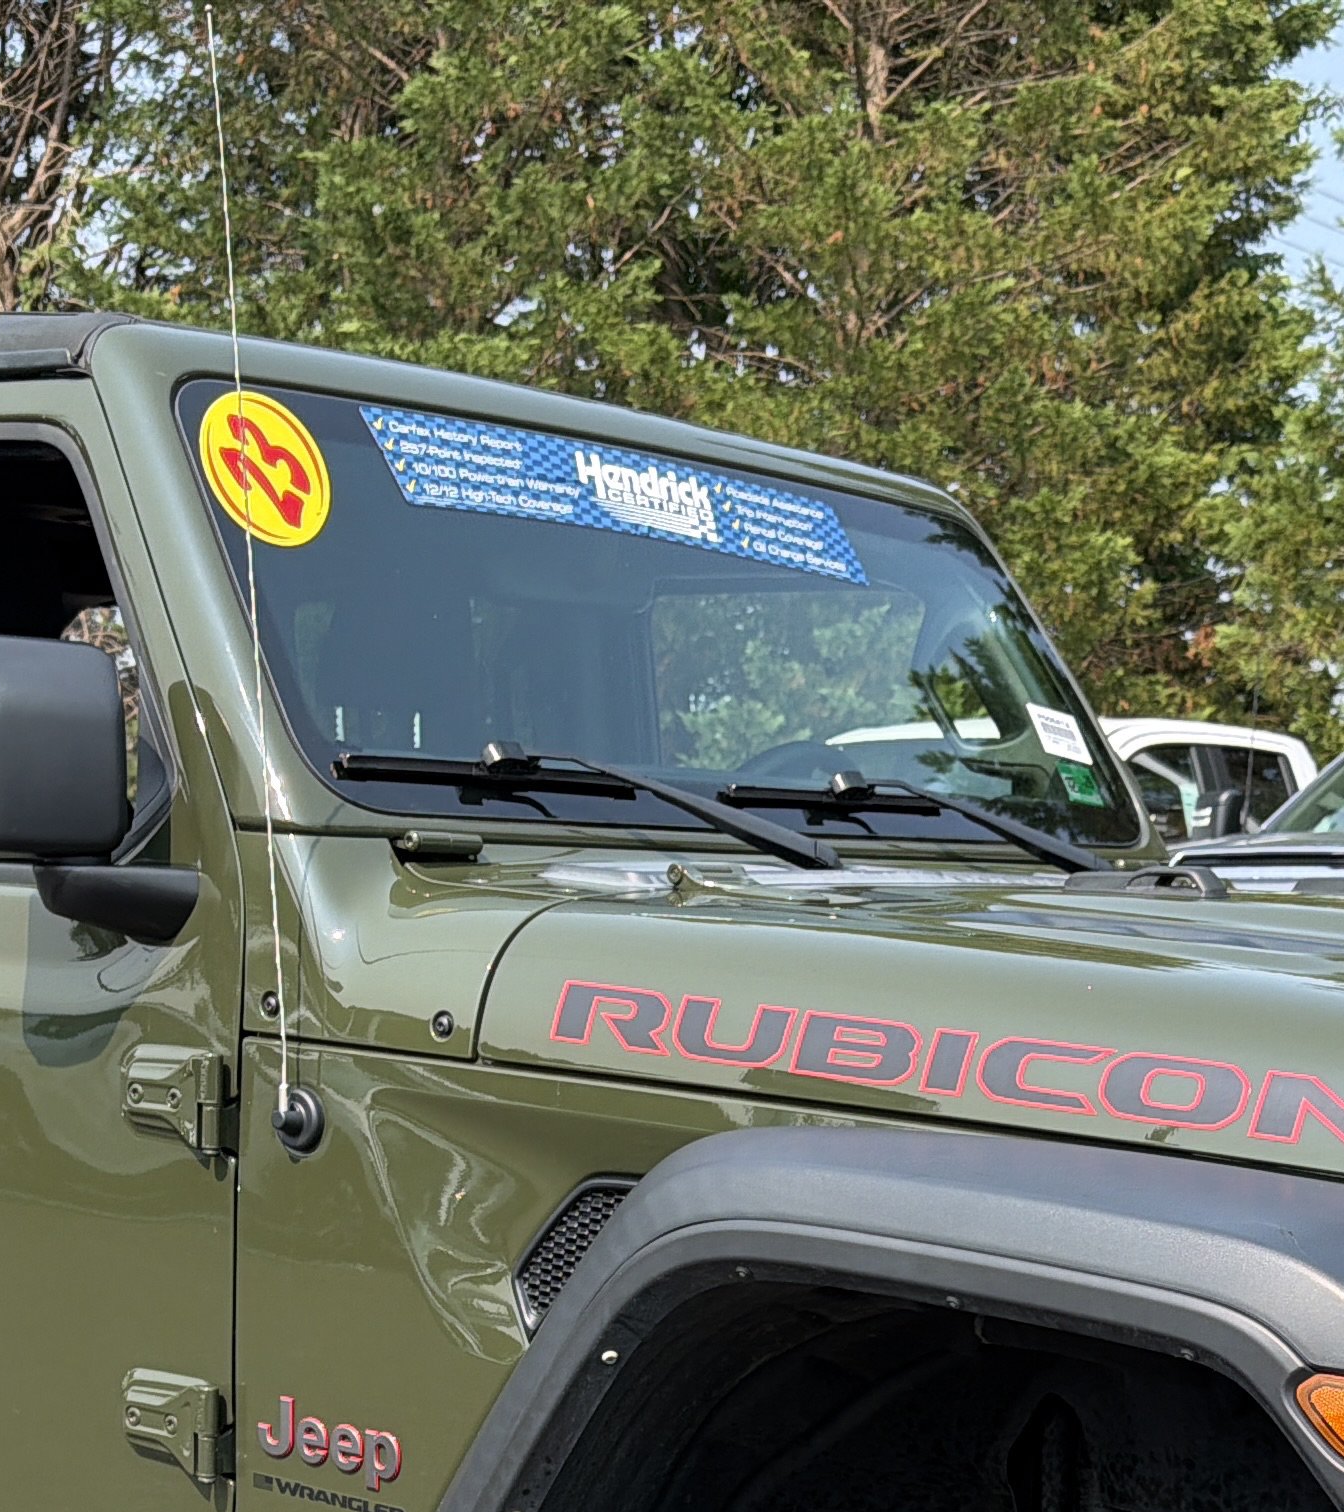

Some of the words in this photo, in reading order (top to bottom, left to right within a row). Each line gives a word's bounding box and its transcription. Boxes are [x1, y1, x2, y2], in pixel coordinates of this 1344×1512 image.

[388, 420, 430, 437] Carfax
[433, 428, 477, 446] History
[480, 435, 523, 452] Report
[219, 413, 311, 529] 23
[463, 449, 523, 470] Inspected
[412, 462, 457, 480] 10/100
[459, 469, 525, 488] Powertrain
[526, 478, 581, 499] Warranty
[575, 451, 712, 511] Hendrick
[423, 482, 460, 498] 12/12
[461, 489, 517, 507] High-Tech
[519, 496, 574, 515] Coverage
[607, 488, 714, 522] CERTIFIED
[772, 498, 825, 520] Assistance
[735, 504, 755, 518] Trip
[756, 510, 814, 532] Interruption
[743, 522, 776, 539] Rental
[777, 528, 824, 551] Coverage
[752, 540, 767, 553] Oil
[768, 543, 805, 563] Change
[258, 1395, 403, 1493] Jeep
